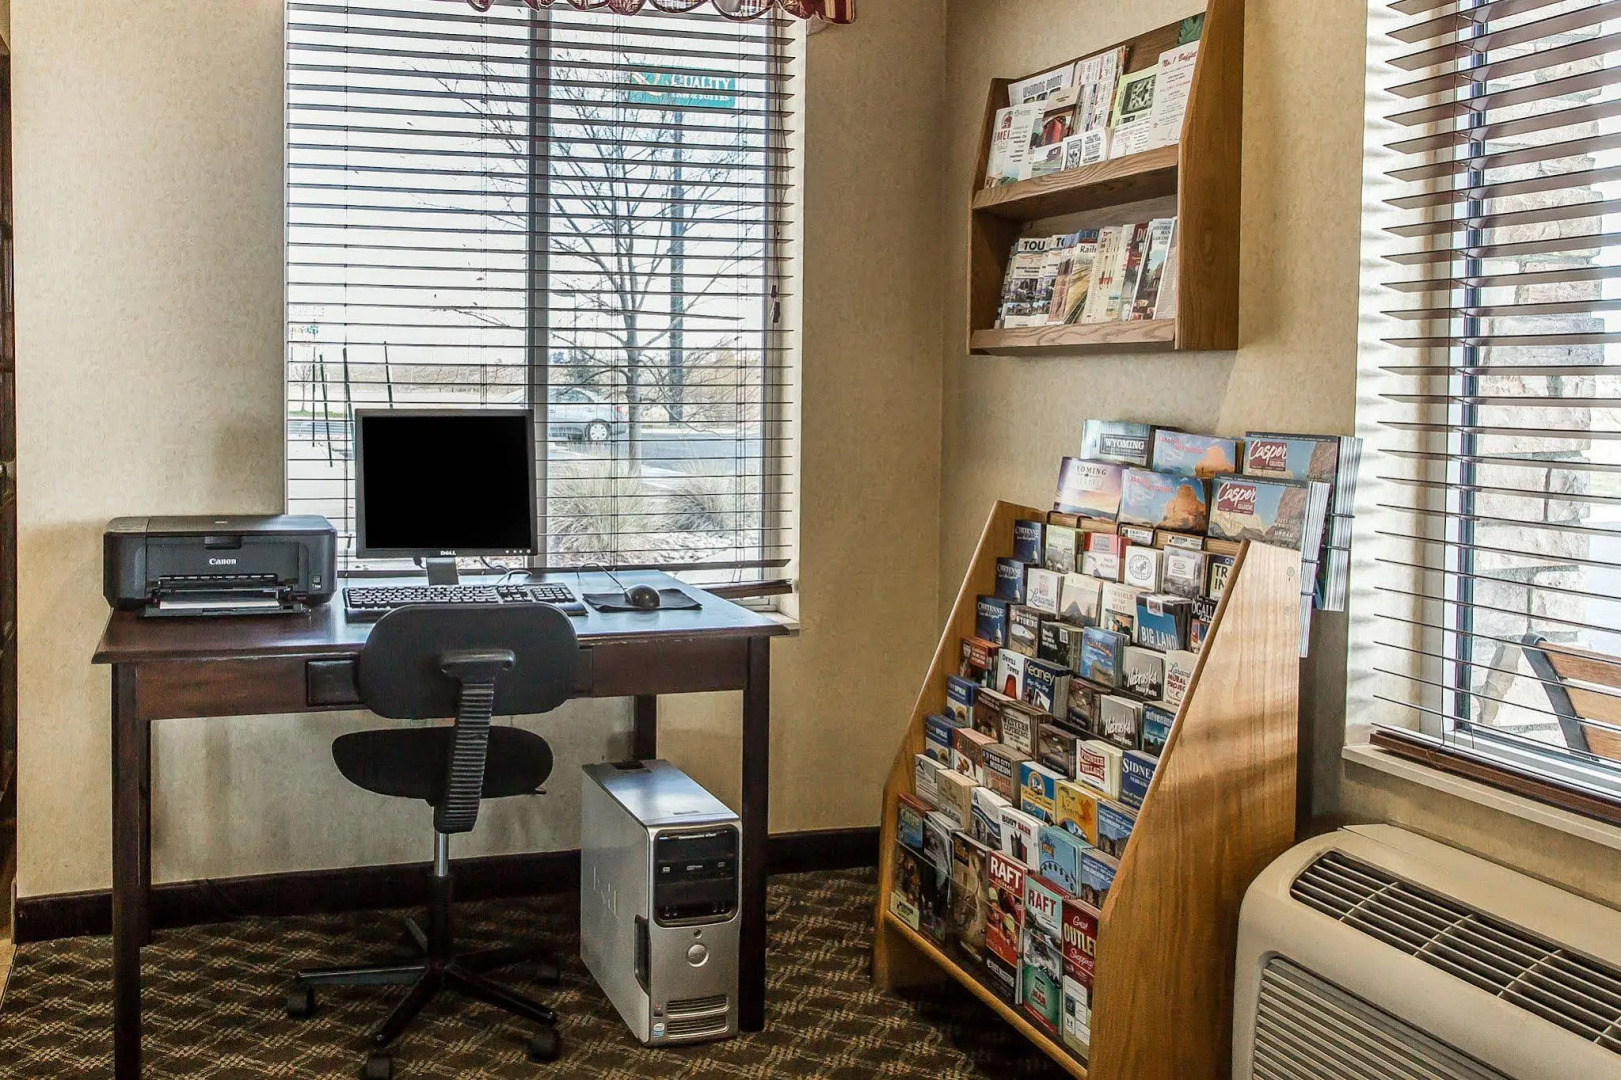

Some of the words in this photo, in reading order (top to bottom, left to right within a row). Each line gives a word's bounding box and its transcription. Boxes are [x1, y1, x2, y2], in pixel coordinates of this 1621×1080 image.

[671, 72, 732, 90] QUALITY
[1104, 438, 1145, 450] WYOMING
[1248, 439, 1287, 465] Casper
[1075, 464, 1108, 476] YOMING
[1269, 460, 1285, 468] GUIDE
[1217, 481, 1257, 509] Casper
[1237, 503, 1253, 511] GUIDE
[1141, 626, 1154, 645] BIG
[1156, 630, 1177, 651] LAND
[1007, 663, 1020, 676] TOWER
[1169, 661, 1192, 679] Larami
[1167, 680, 1186, 692] PROJEC
[1081, 763, 1105, 779] VILLAGE
[990, 855, 1022, 889] RAFT
[1028, 889, 1057, 917] RAFT
[1063, 922, 1096, 958] OUTLET
